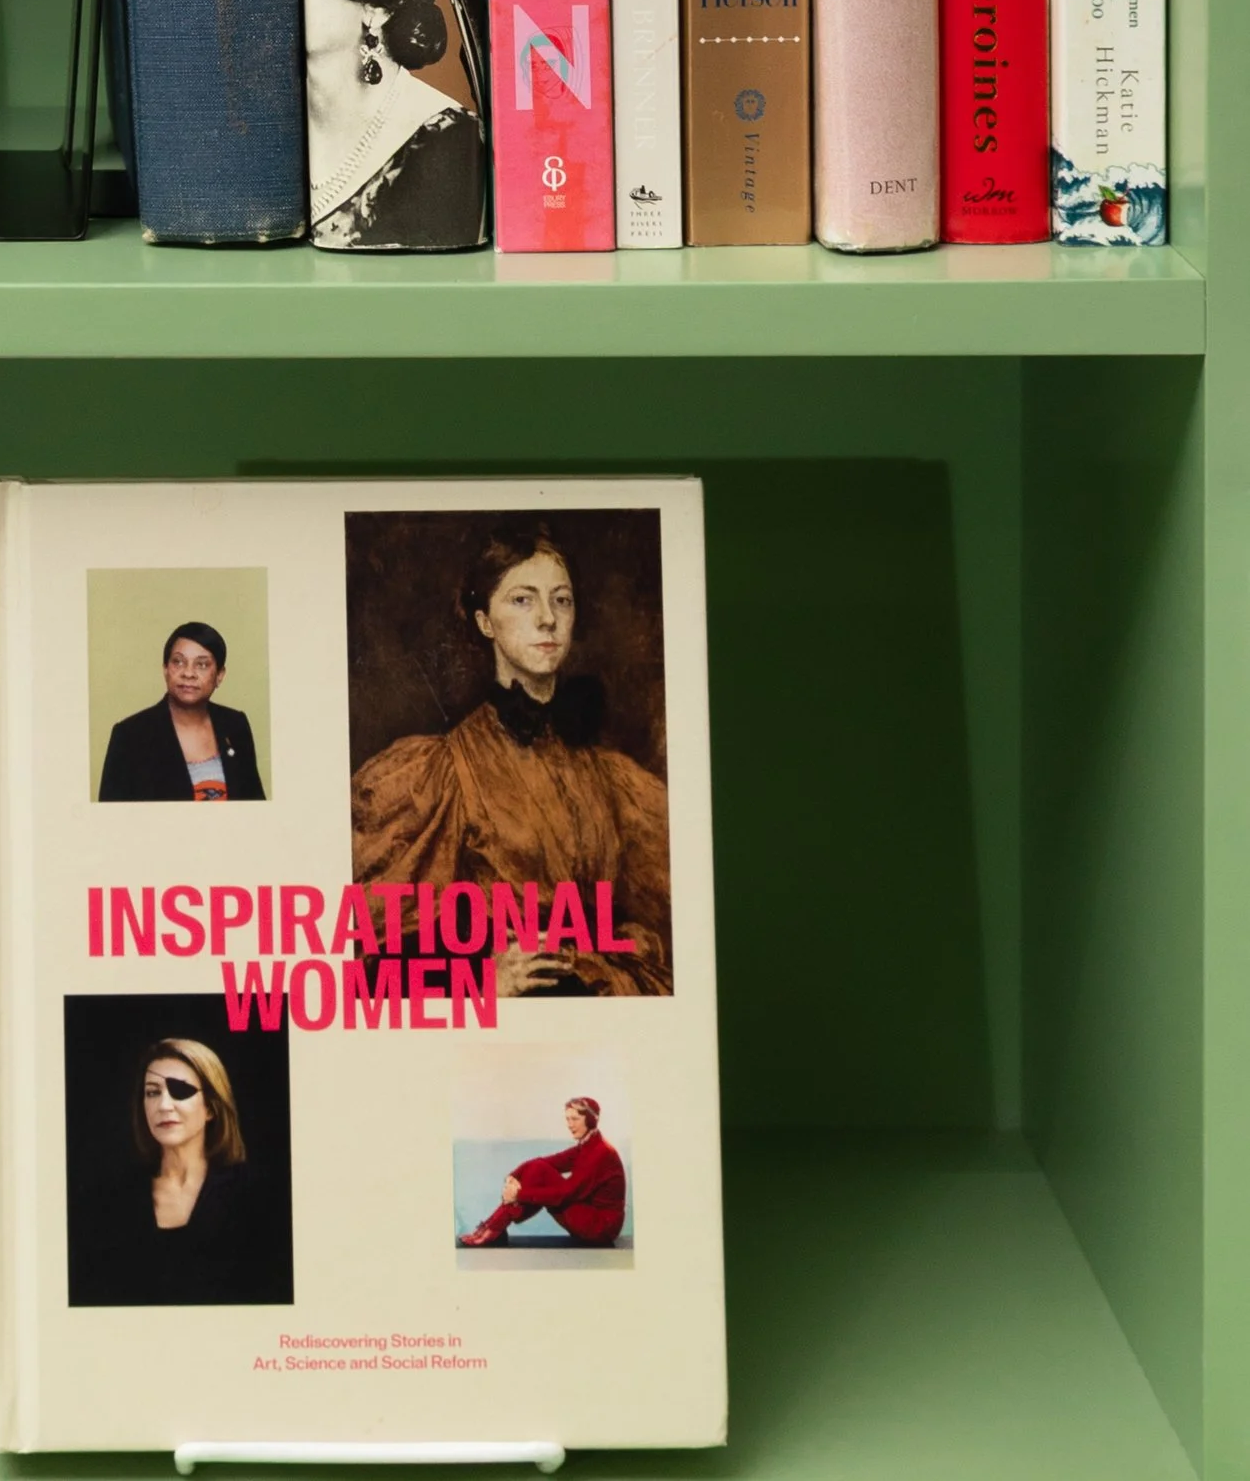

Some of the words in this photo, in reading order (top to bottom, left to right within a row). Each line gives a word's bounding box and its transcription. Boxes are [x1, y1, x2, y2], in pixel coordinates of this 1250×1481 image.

[1096, 46, 1114, 156] Hickman
[1119, 69, 1139, 134] Katie
[869, 178, 918, 195] DENT
[87, 881, 636, 958] INSPIRATIONAL
[221, 959, 498, 1032] WOMEN
[253, 1356, 282, 1372] Art,
[285, 1356, 346, 1370] Science
[349, 1356, 378, 1370] and
[381, 1355, 428, 1369] Social
[431, 1355, 487, 1369] Reform
[279, 1334, 388, 1351] Rediscovering
[391, 1333, 444, 1348] Stories
[449, 1334, 461, 1347] in
